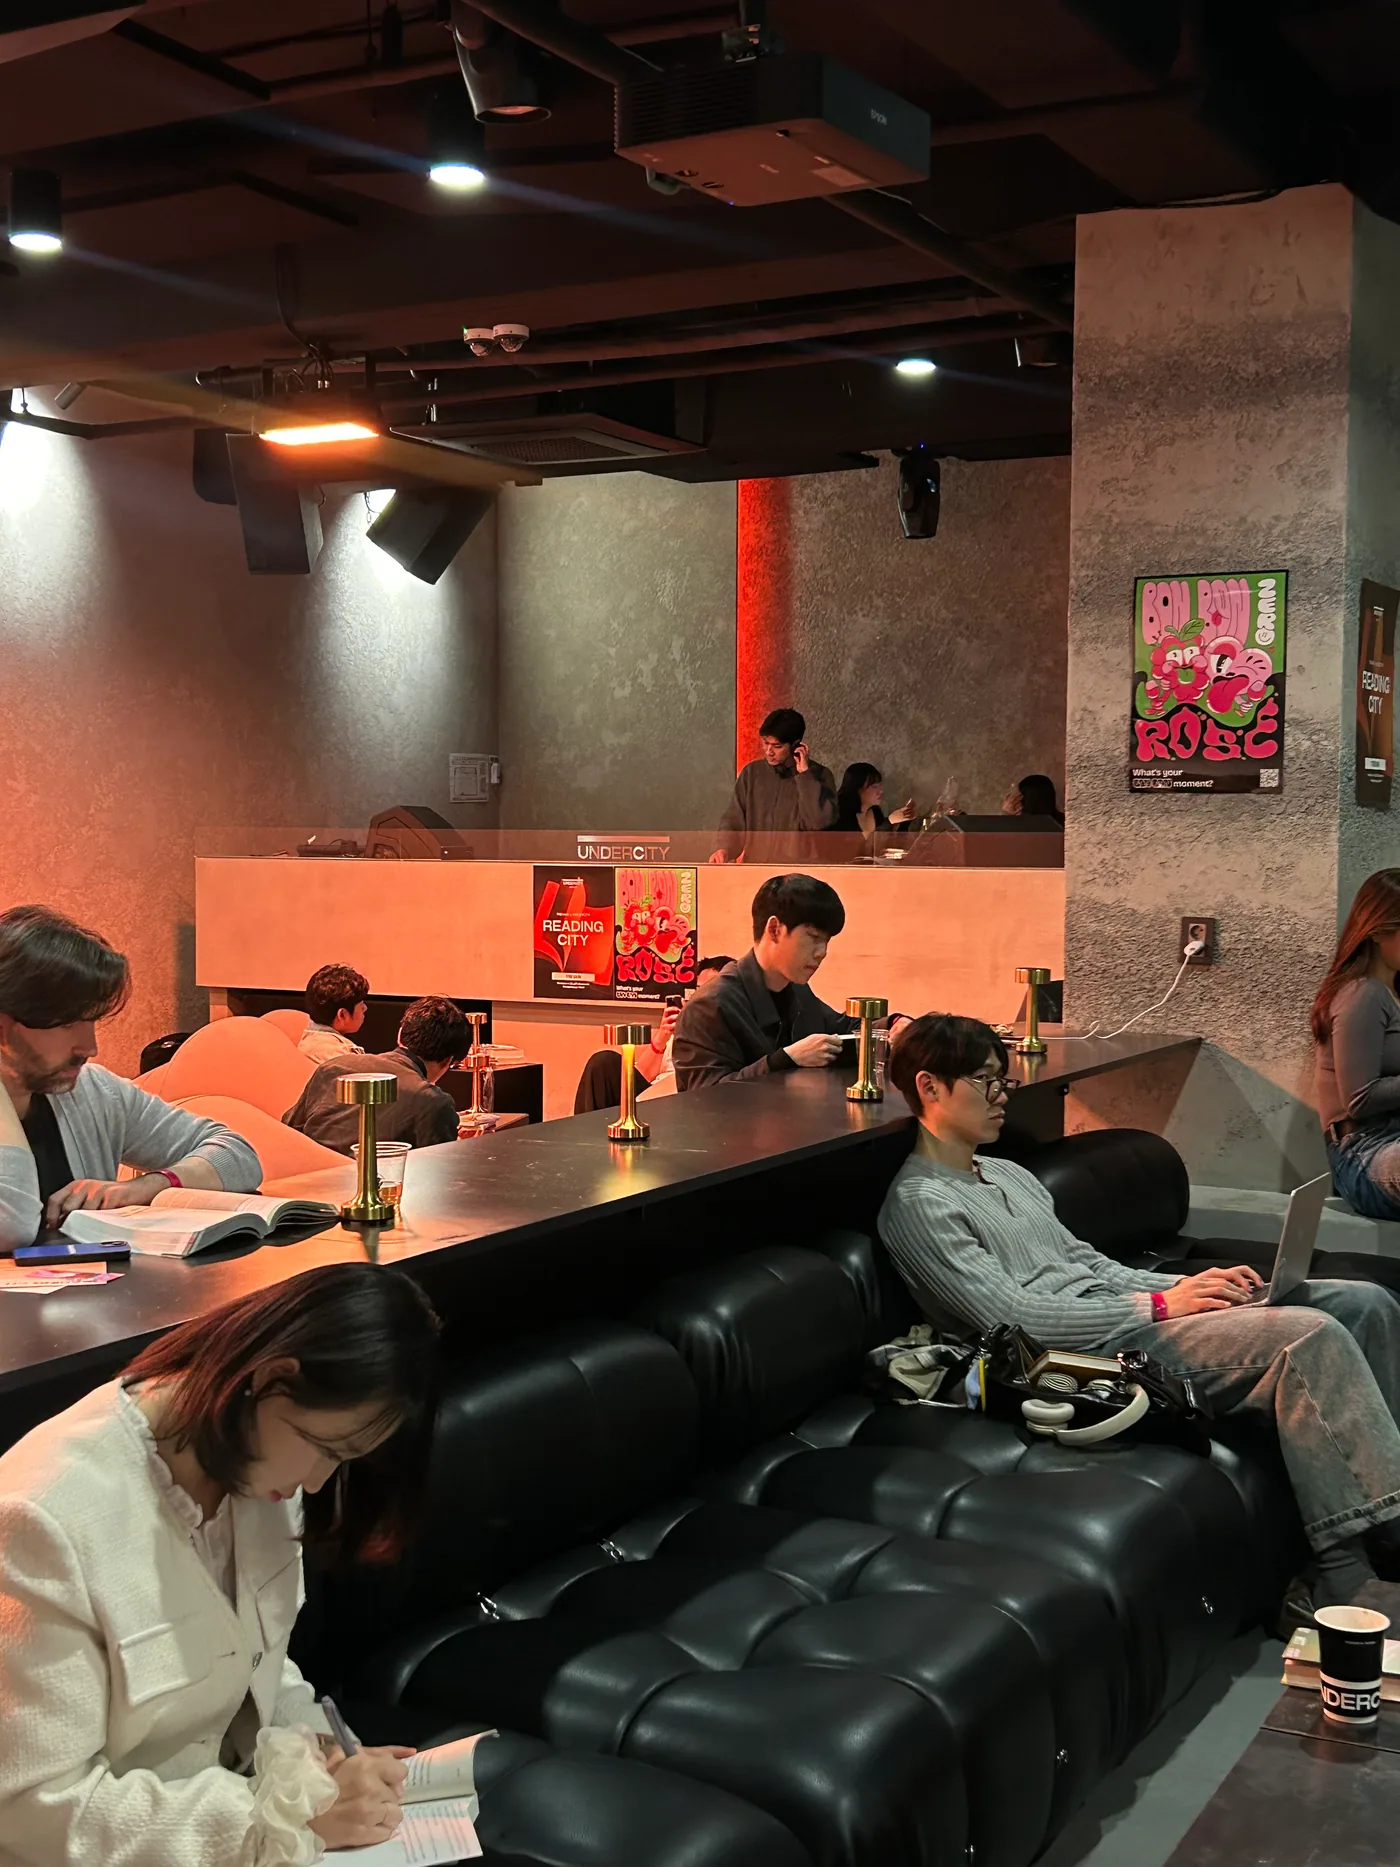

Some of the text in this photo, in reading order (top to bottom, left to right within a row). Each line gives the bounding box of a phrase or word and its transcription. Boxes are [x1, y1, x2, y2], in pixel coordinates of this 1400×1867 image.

[1362, 670, 1391, 694] READING
[1368, 695, 1384, 715] CITY
[1132, 768, 1183, 778] What's your
[1173, 779, 1214, 788] moment?
[577, 845, 671, 861] UNDERCITY
[542, 919, 604, 933] READING
[557, 934, 589, 946] CITY
